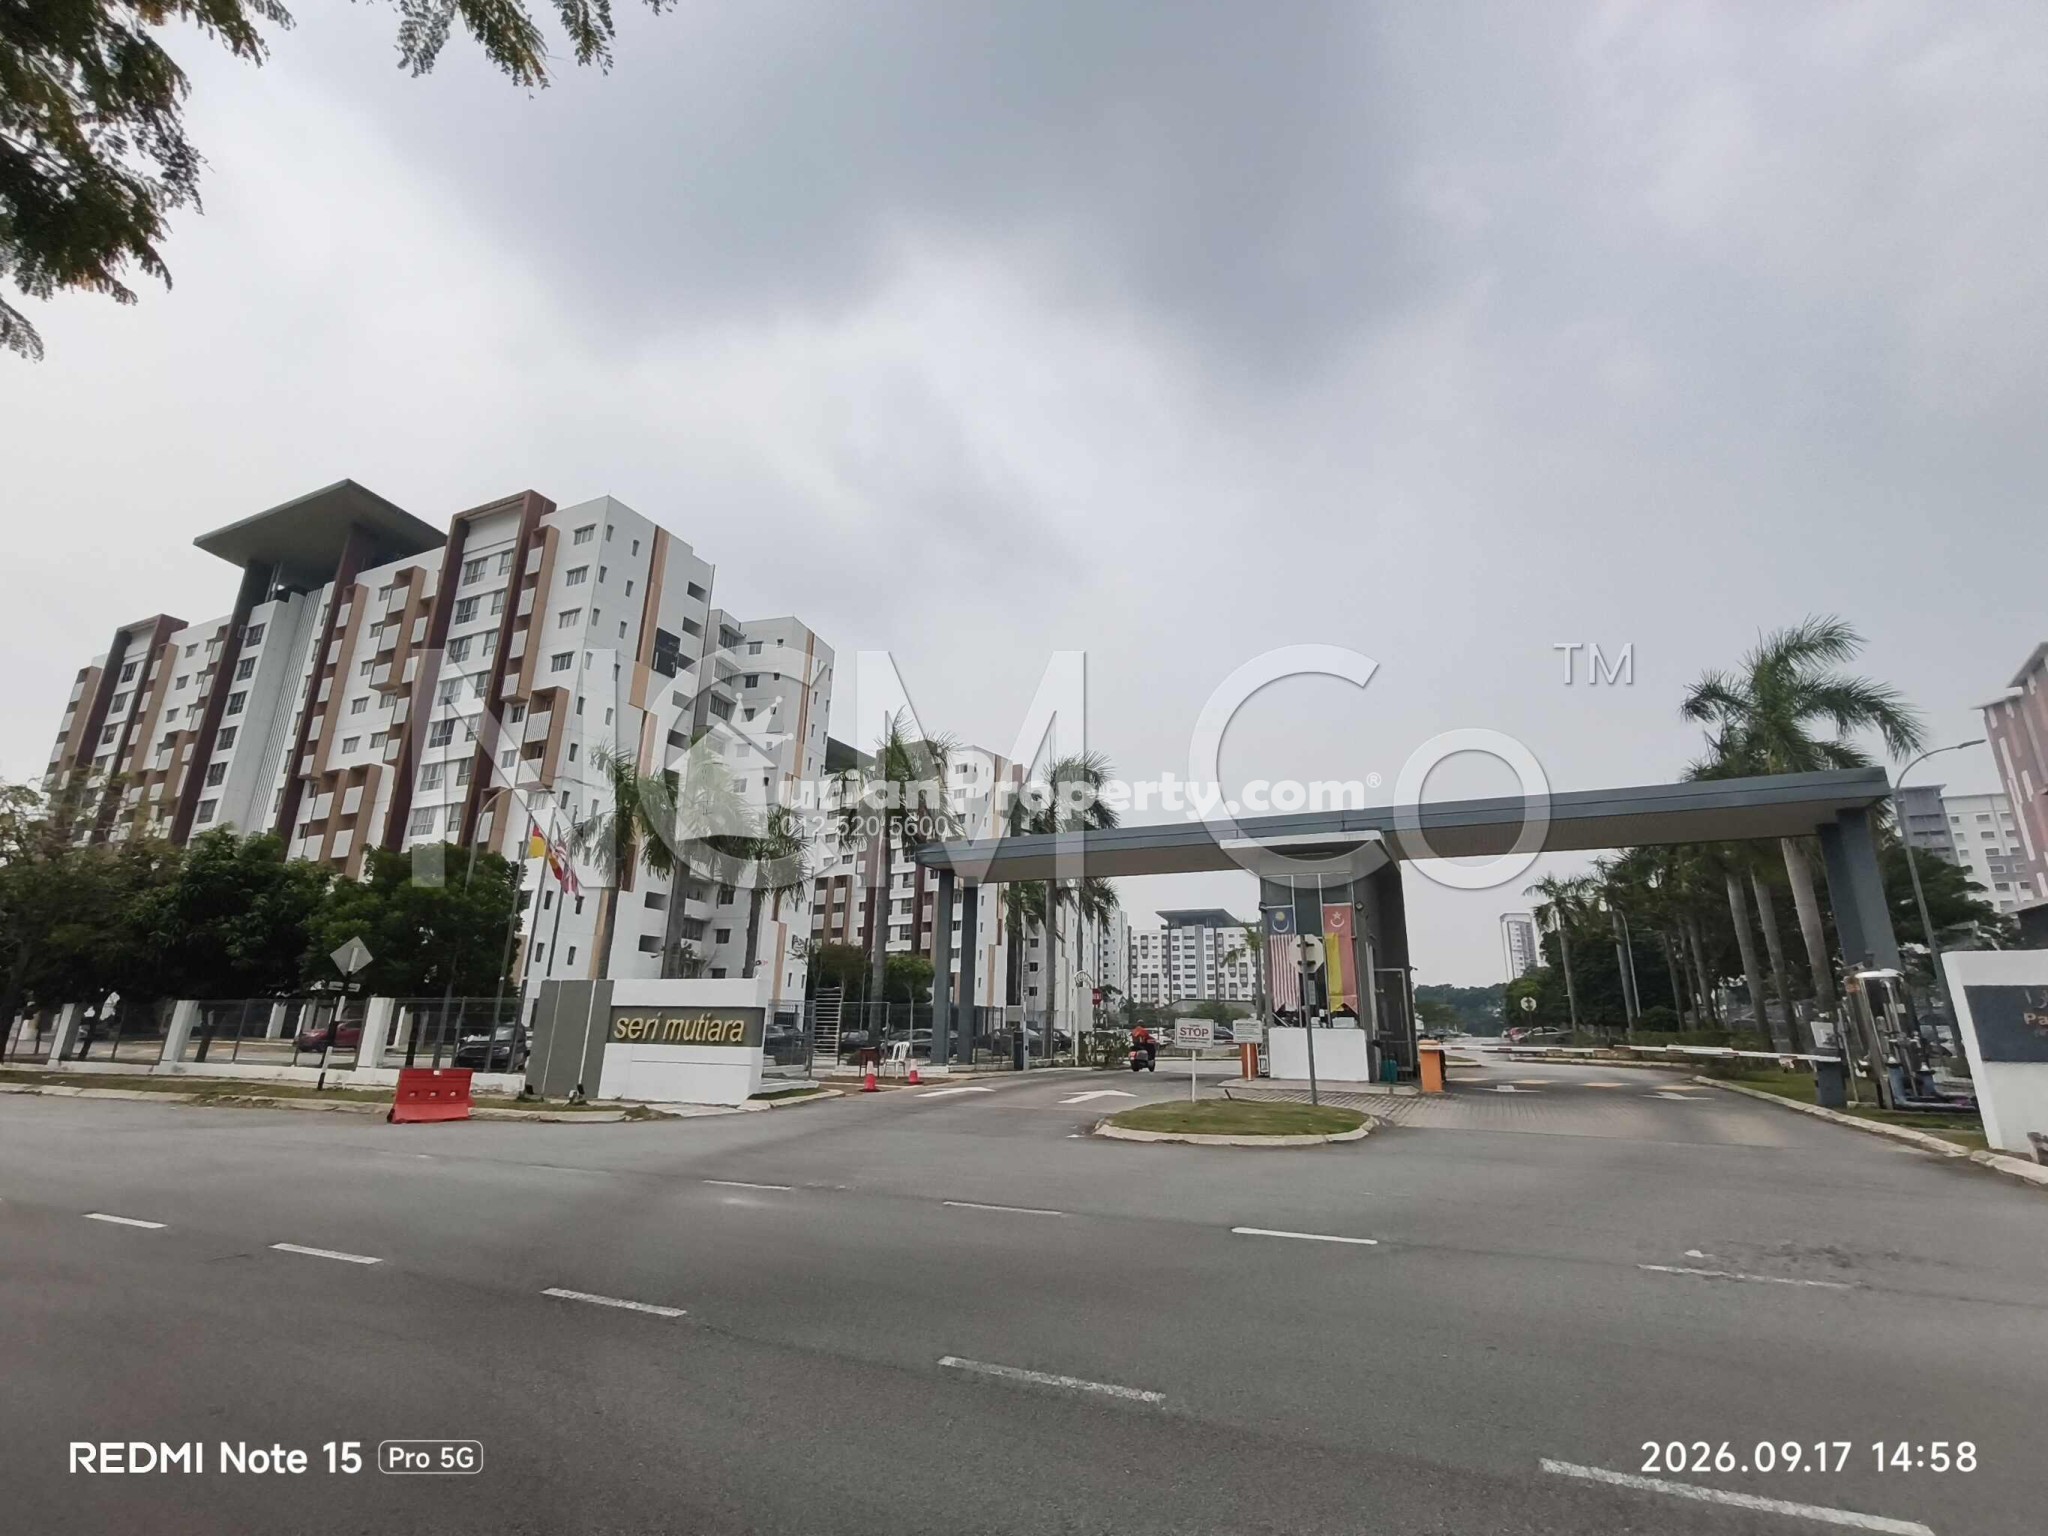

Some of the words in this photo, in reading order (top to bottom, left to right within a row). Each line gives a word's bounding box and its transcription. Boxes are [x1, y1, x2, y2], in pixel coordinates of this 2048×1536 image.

[613, 1012, 662, 1040] seri
[662, 1013, 745, 1042] mutiara
[1180, 1027, 1209, 1037] STOP
